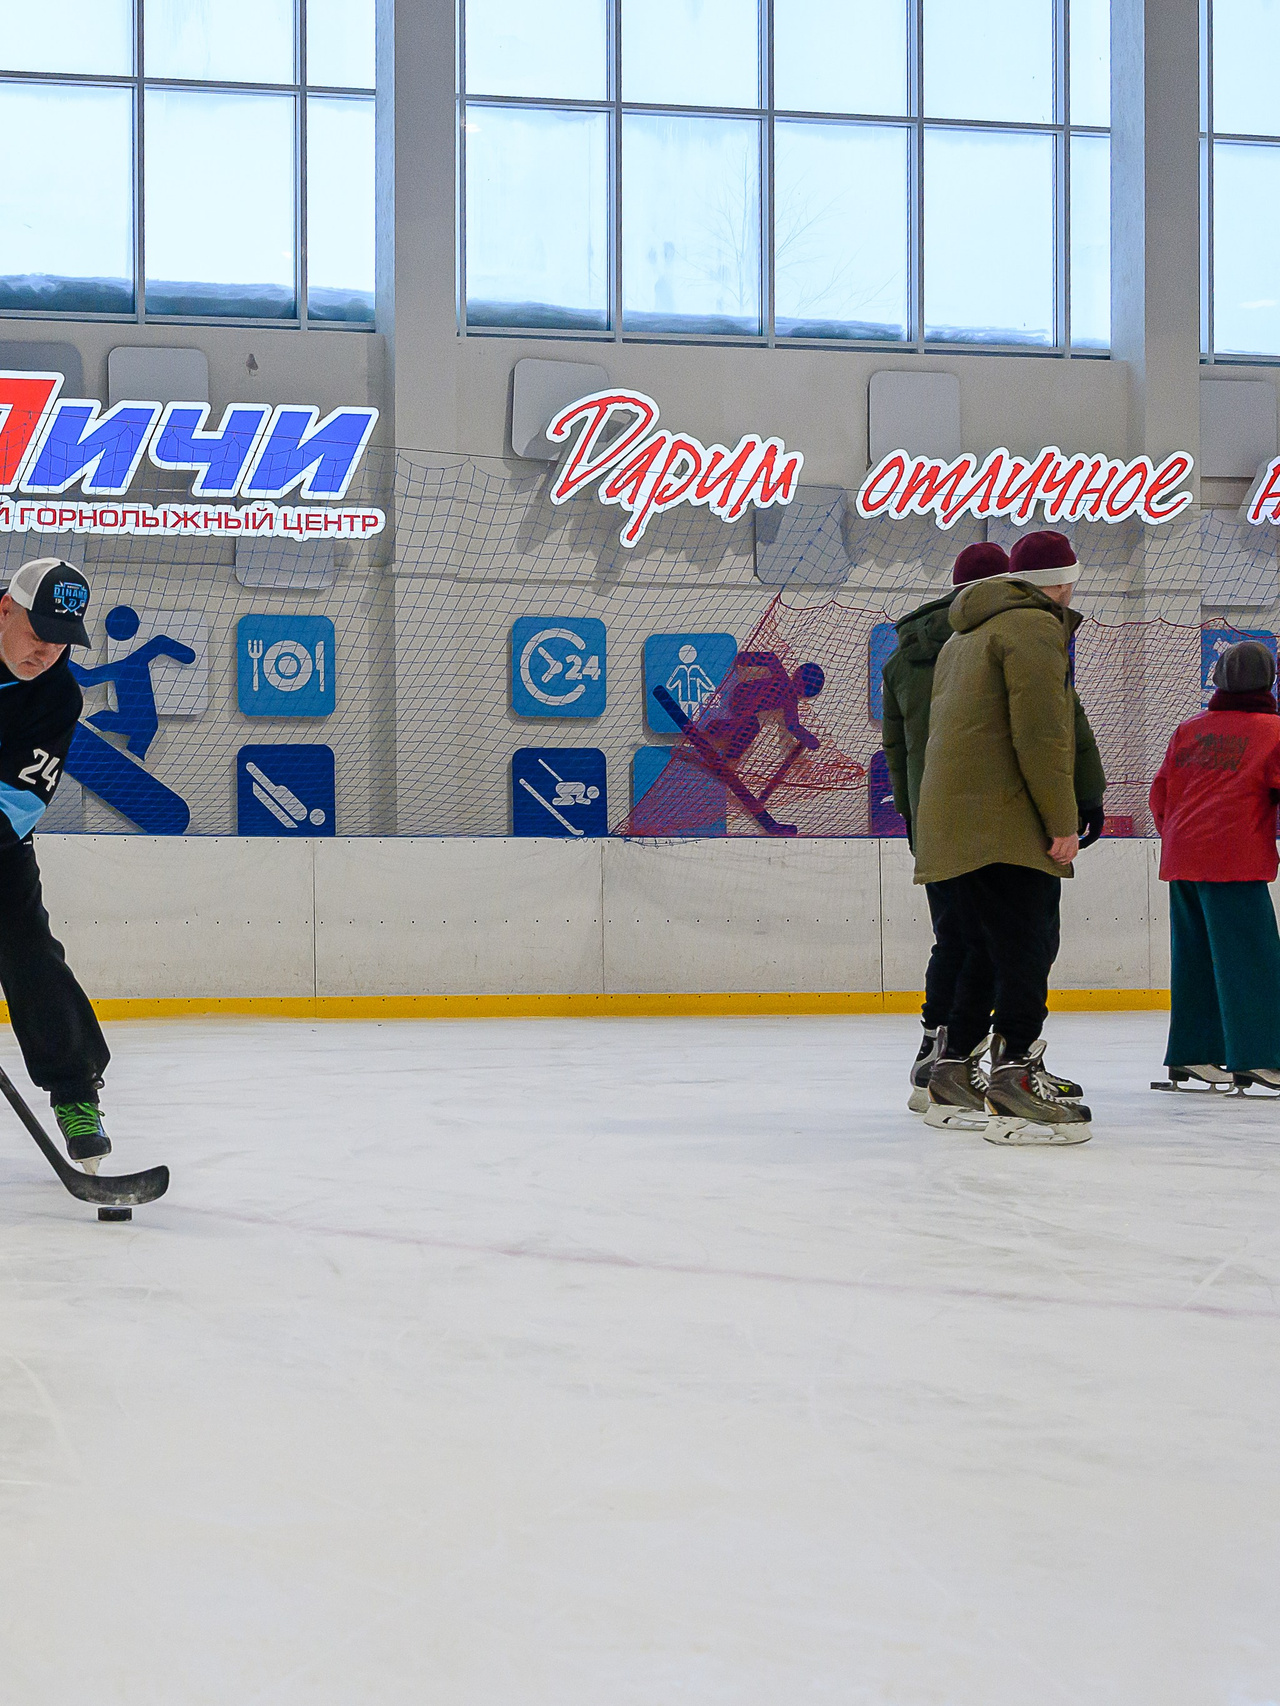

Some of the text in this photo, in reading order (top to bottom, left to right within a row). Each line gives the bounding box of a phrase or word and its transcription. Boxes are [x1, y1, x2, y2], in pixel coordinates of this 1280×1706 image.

[553, 395, 798, 541] Дарим
[861, 452, 1193, 524] отличное
[20, 507, 274, 530] ГОРНОЛЫЖНЫЙ
[283, 512, 379, 535] ЦЕНТР
[565, 654, 601, 680] 24
[18, 748, 60, 792] 24
